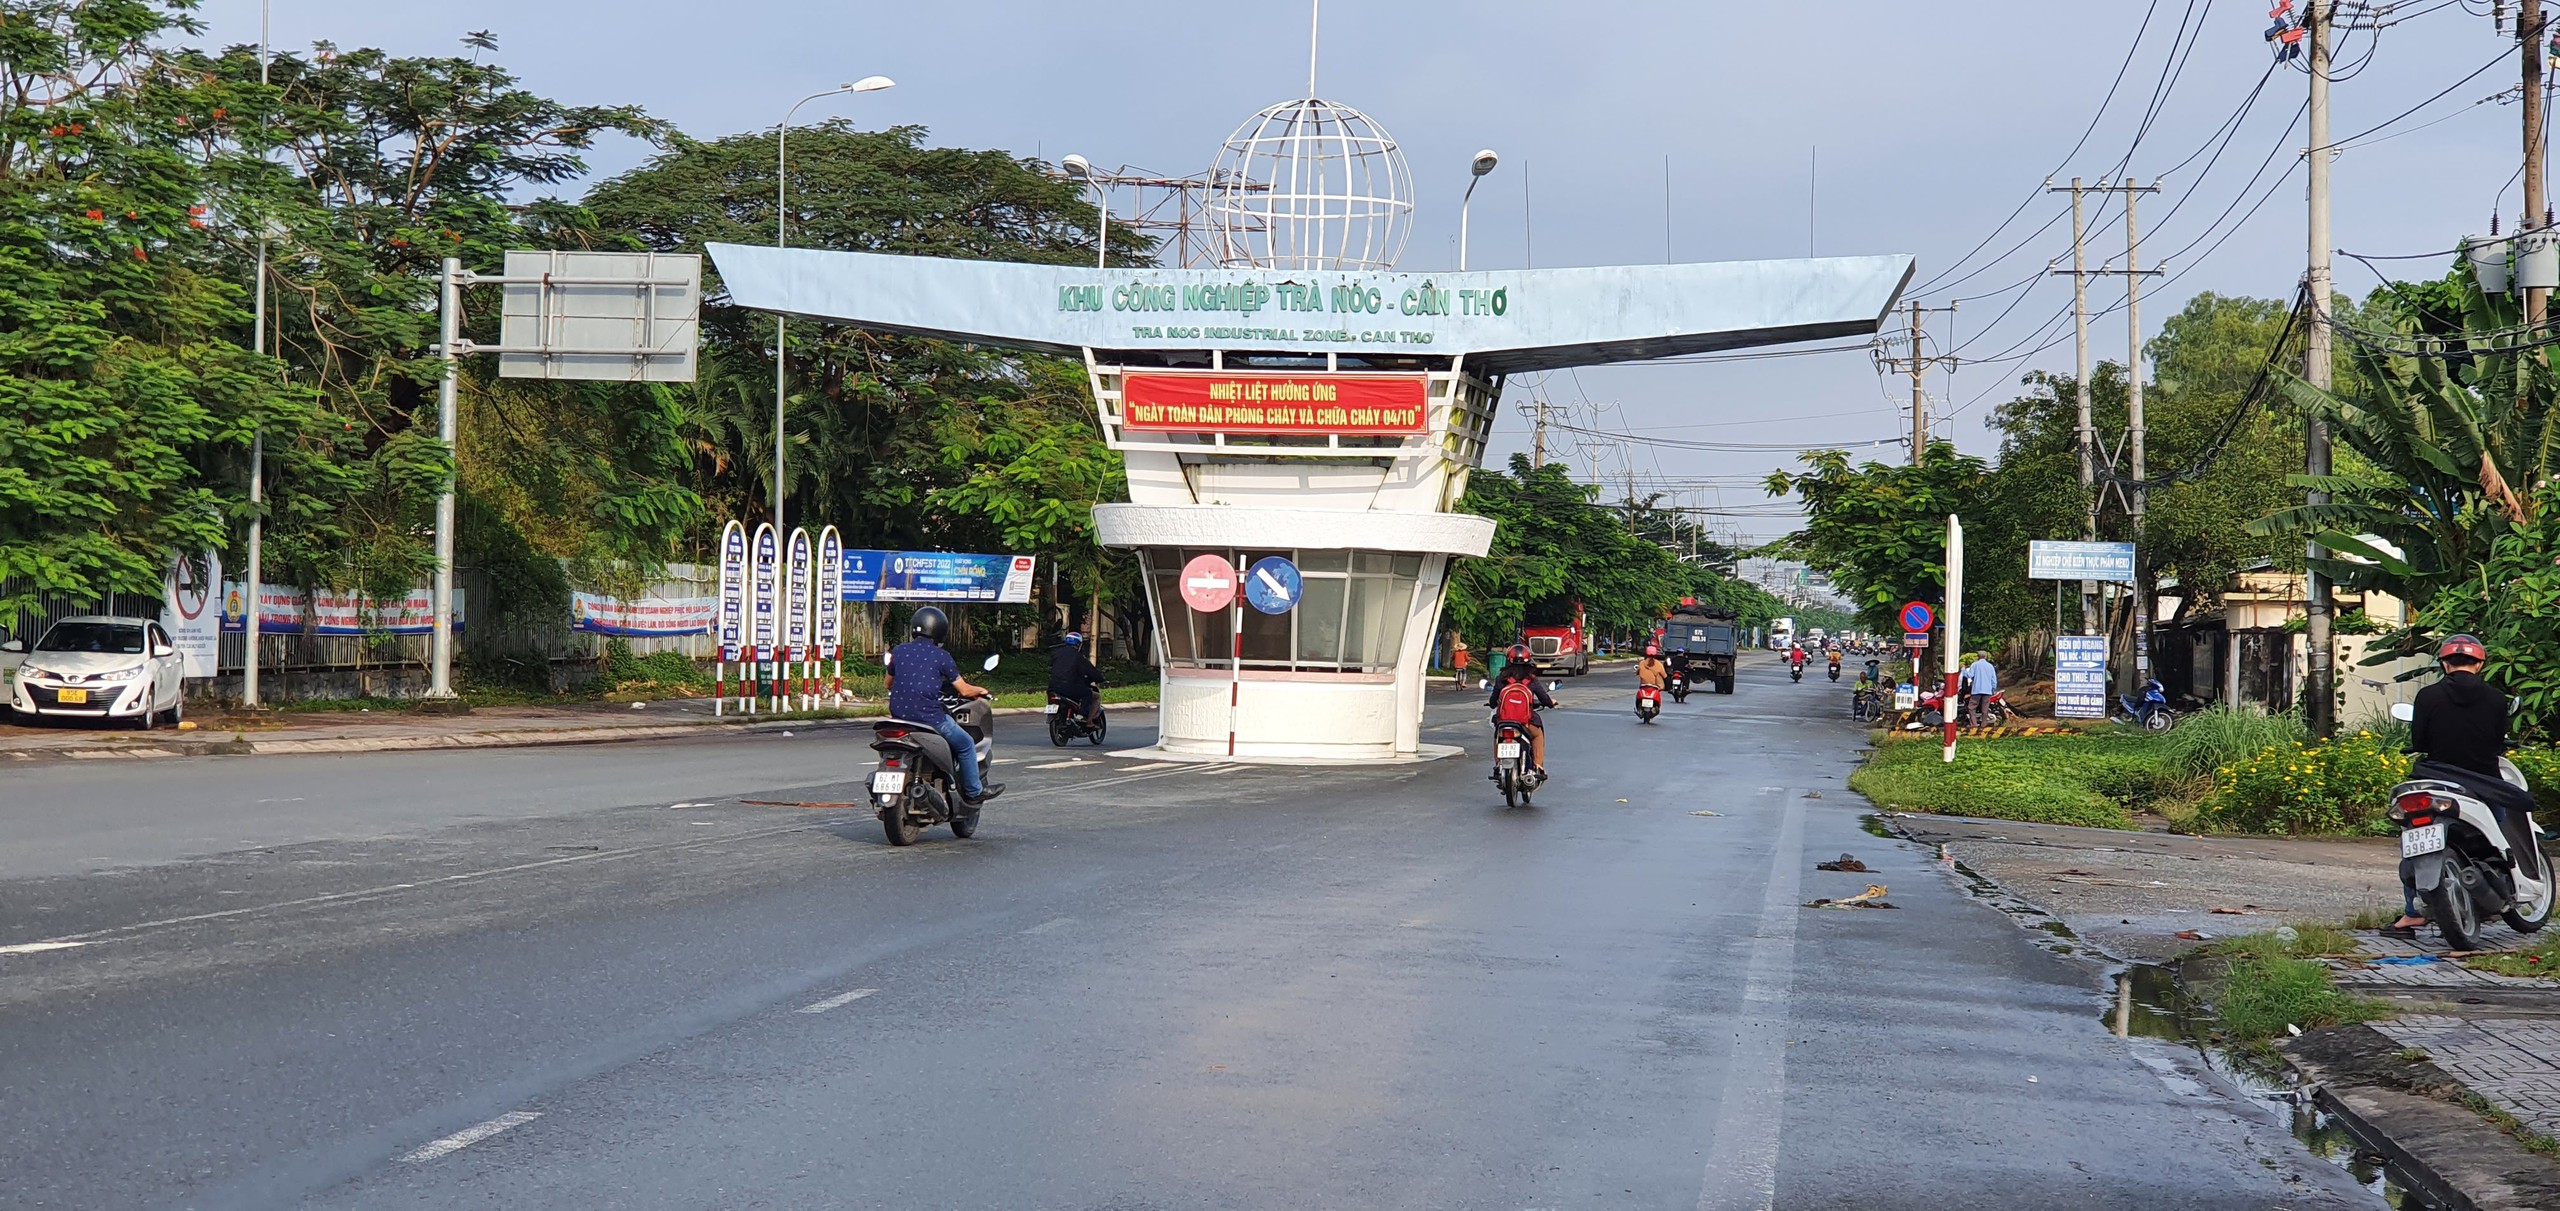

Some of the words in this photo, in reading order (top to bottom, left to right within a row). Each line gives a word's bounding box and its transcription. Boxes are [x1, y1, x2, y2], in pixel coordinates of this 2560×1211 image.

[1058, 285, 1104, 312] KHU
[1111, 278, 1176, 312] CÔNG
[1182, 278, 1271, 318] NGHIỆP
[1276, 279, 1324, 312] TRÀ
[1400, 279, 1451, 316] CẦN
[1458, 285, 1508, 317] THƠ
[1132, 326, 1164, 339] TRA
[1166, 327, 1201, 339] NOC
[1204, 327, 1299, 341] INDUSTRIAL
[1302, 329, 1347, 342] ZONE
[1360, 331, 1396, 343] CAN
[1209, 380, 1243, 404] NHIỆT
[1245, 381, 1269, 404] LIỆT
[1270, 379, 1310, 402] HƯỞNG
[1312, 381, 1337, 402] ỨNG
[1167, 403, 1197, 424] TOÀN
[1199, 403, 1223, 425] DÂN
[1225, 404, 1265, 425] PHÒNG
[1266, 404, 1297, 426] CHÁY
[1298, 405, 1315, 426] VÀ
[1316, 405, 1348, 426] CHỮA
[1350, 405, 1381, 427] CHÁY
[904, 557, 937, 569] TCHFEST
[937, 559, 951, 569] 2022
[2042, 553, 2062, 570] NGHIỆP
[2085, 555, 2100, 571] THỰC
[2115, 556, 2130, 570] MEKO
[2058, 637, 2072, 650] BẾN
[2081, 640, 2104, 650] NGANG
[2057, 672, 2071, 683] CHO
[2072, 670, 2089, 683] THUÊ
[2089, 672, 2103, 683] KHO
[2404, 837, 2442, 856] 398.33
